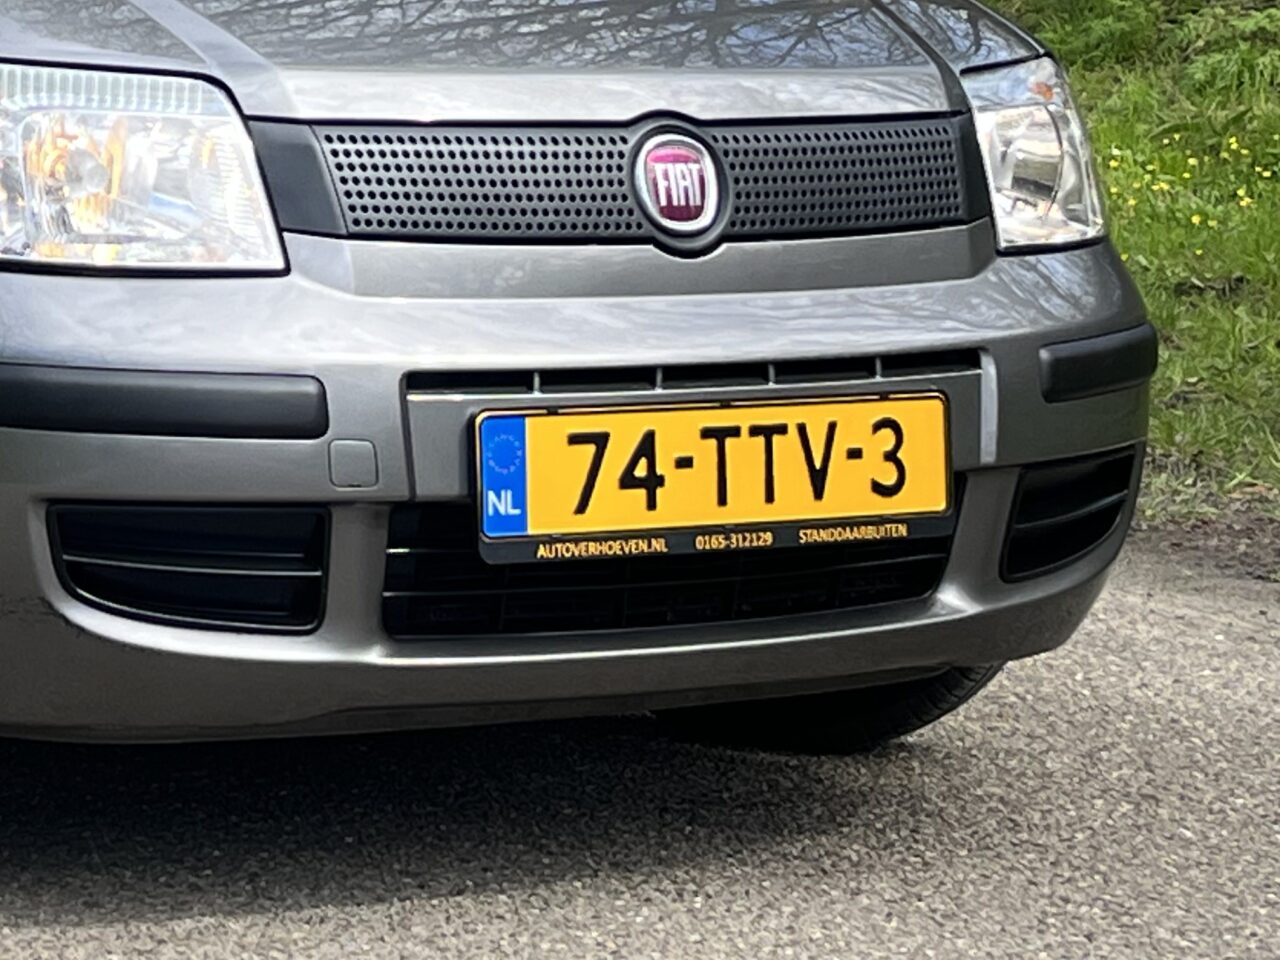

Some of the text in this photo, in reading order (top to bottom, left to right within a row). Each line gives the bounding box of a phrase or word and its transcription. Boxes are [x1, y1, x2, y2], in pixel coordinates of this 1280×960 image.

[654, 162, 702, 206] FIAT
[567, 417, 907, 515] 74-TTV-3
[488, 491, 520, 516] NL
[537, 538, 668, 558] AUTOVERHOEVEN.NL
[695, 532, 773, 550] 0165-312129
